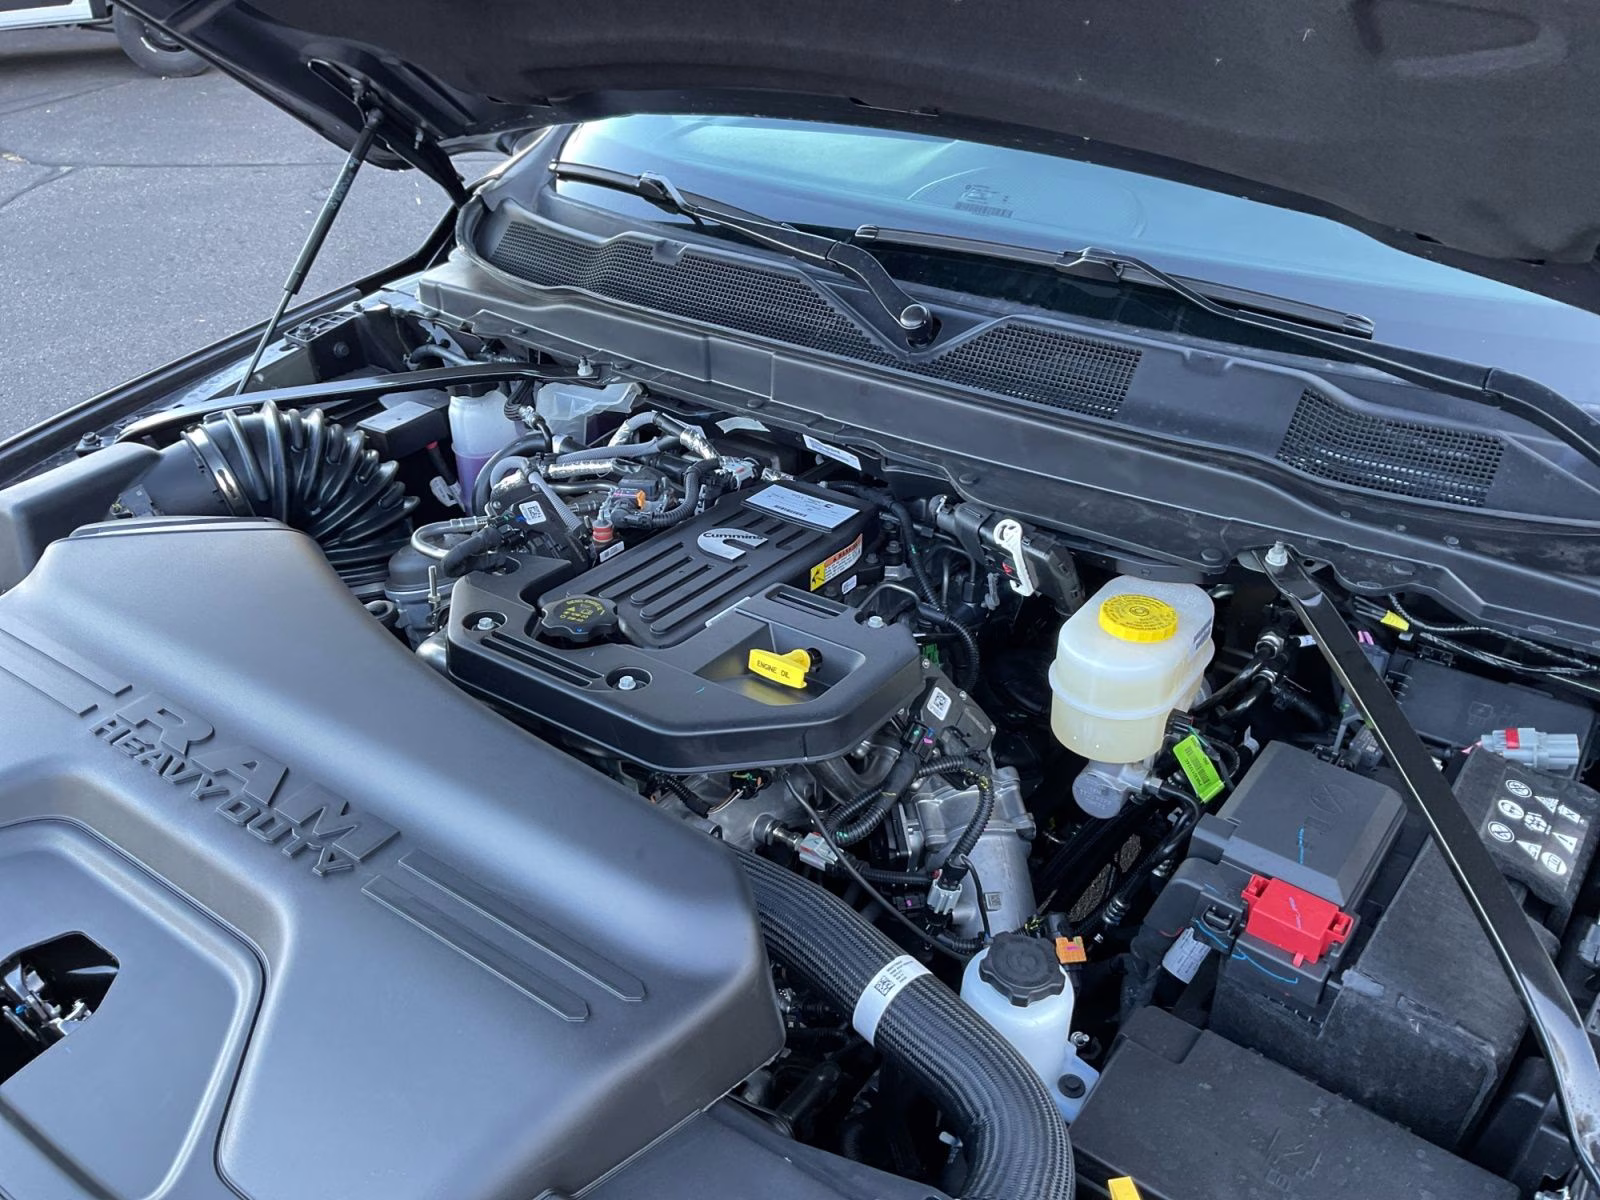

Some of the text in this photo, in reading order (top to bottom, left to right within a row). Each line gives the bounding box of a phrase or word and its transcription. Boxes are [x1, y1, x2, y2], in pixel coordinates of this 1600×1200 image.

[702, 532, 764, 540] Cummins
[756, 660, 791, 679] ENGINE OIL
[89, 716, 354, 877] HEAVY DUTY
[114, 691, 401, 862] RAM
